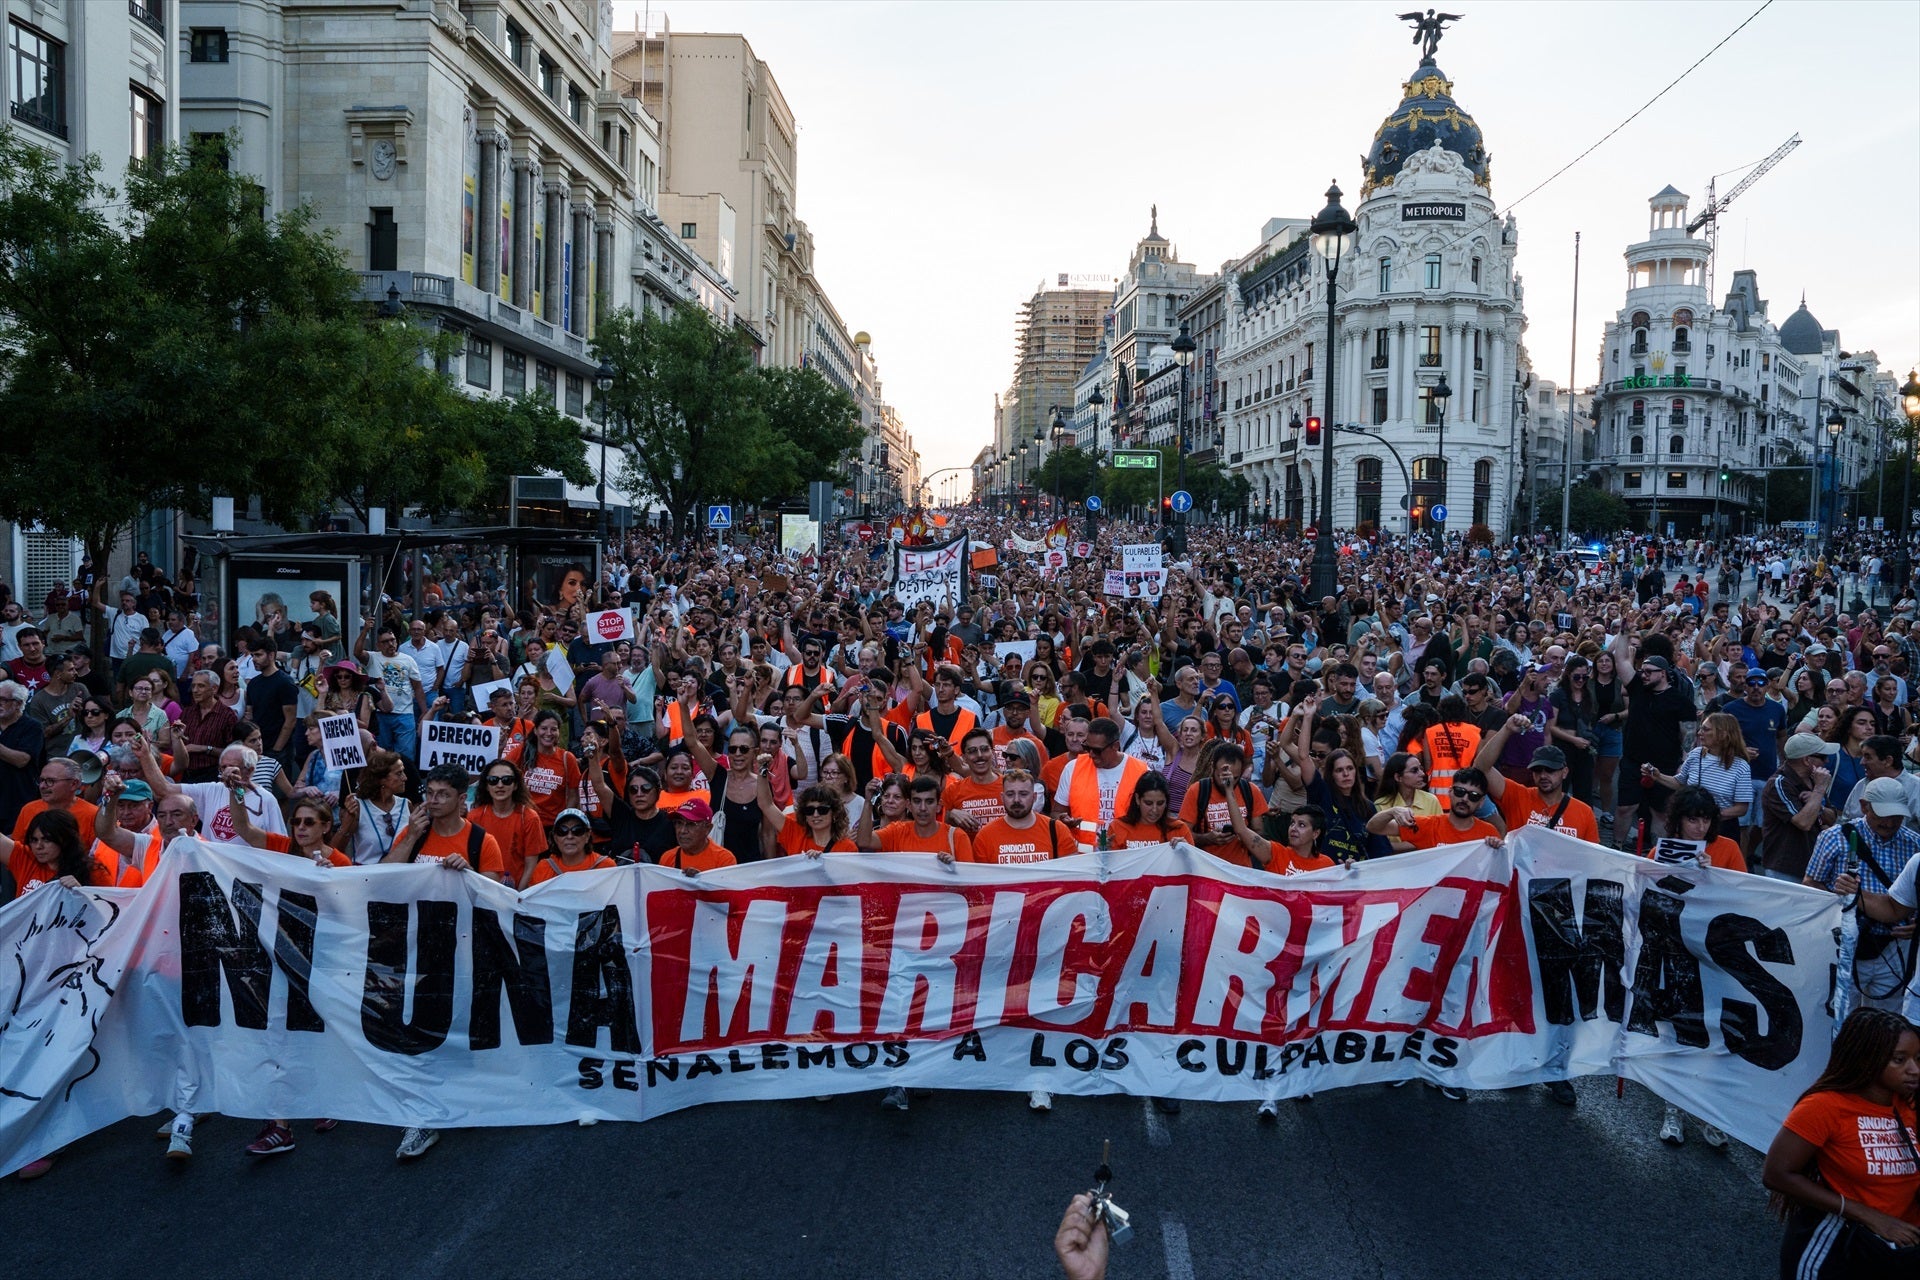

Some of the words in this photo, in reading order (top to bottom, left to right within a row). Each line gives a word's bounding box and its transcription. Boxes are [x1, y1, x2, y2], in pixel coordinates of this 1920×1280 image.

[1406, 206, 1463, 216] METROPOLIS
[1624, 374, 1693, 390] ROLEX
[905, 542, 960, 573] ELIX
[1124, 546, 1160, 556] CULPABLES
[599, 616, 622, 627] STOP
[322, 717, 355, 740] DERECHO
[428, 724, 493, 748] DERECHO
[429, 750, 438, 767] A
[962, 798, 998, 809] SINDICATO
[999, 843, 1035, 854] SINDICATO
[1126, 840, 1160, 849] SINDICATO
[1000, 856, 1008, 864] DE
[1010, 854, 1048, 864] INQUILINAS
[179, 871, 325, 1033] NI
[361, 899, 643, 1055] UNA
[679, 885, 1508, 1042] MARICARMEN
[1528, 874, 1803, 1071] MÁS
[578, 1040, 910, 1091] SEÑALEMOS
[953, 1030, 987, 1062] A
[1030, 1033, 1129, 1072] LOS
[1176, 1031, 1459, 1080] CULPABLES
[1858, 1116, 1899, 1130] SINDICA
[1862, 1133, 1875, 1145] DE
[1864, 1148, 1872, 1160] E
[1868, 1161, 1881, 1175] DE
[1883, 1161, 1917, 1176] MADRID
